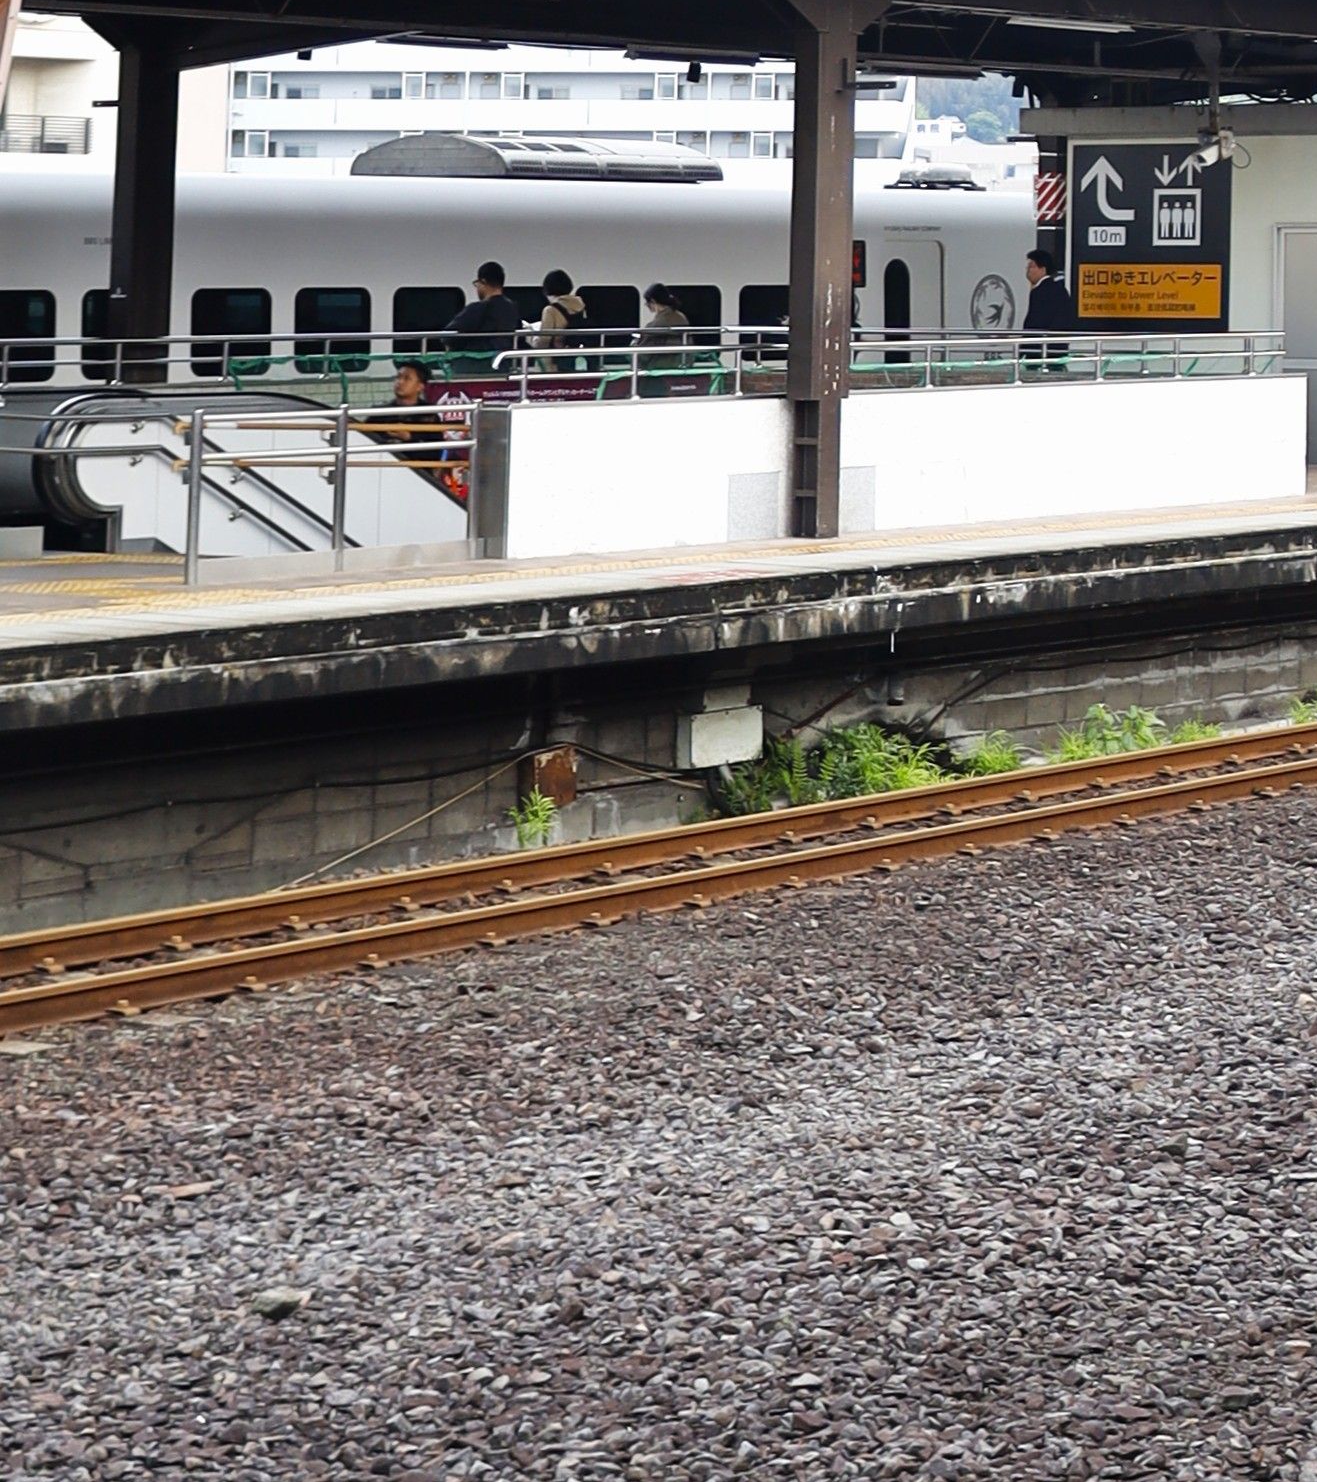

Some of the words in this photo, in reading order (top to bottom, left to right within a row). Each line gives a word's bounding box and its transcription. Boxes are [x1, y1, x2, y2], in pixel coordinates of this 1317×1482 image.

[1092, 229, 1123, 244] 10m
[1082, 270, 1218, 286] 出口ゆきエレベーター
[1082, 290, 1115, 299] Elevator
[1118, 290, 1126, 299] to
